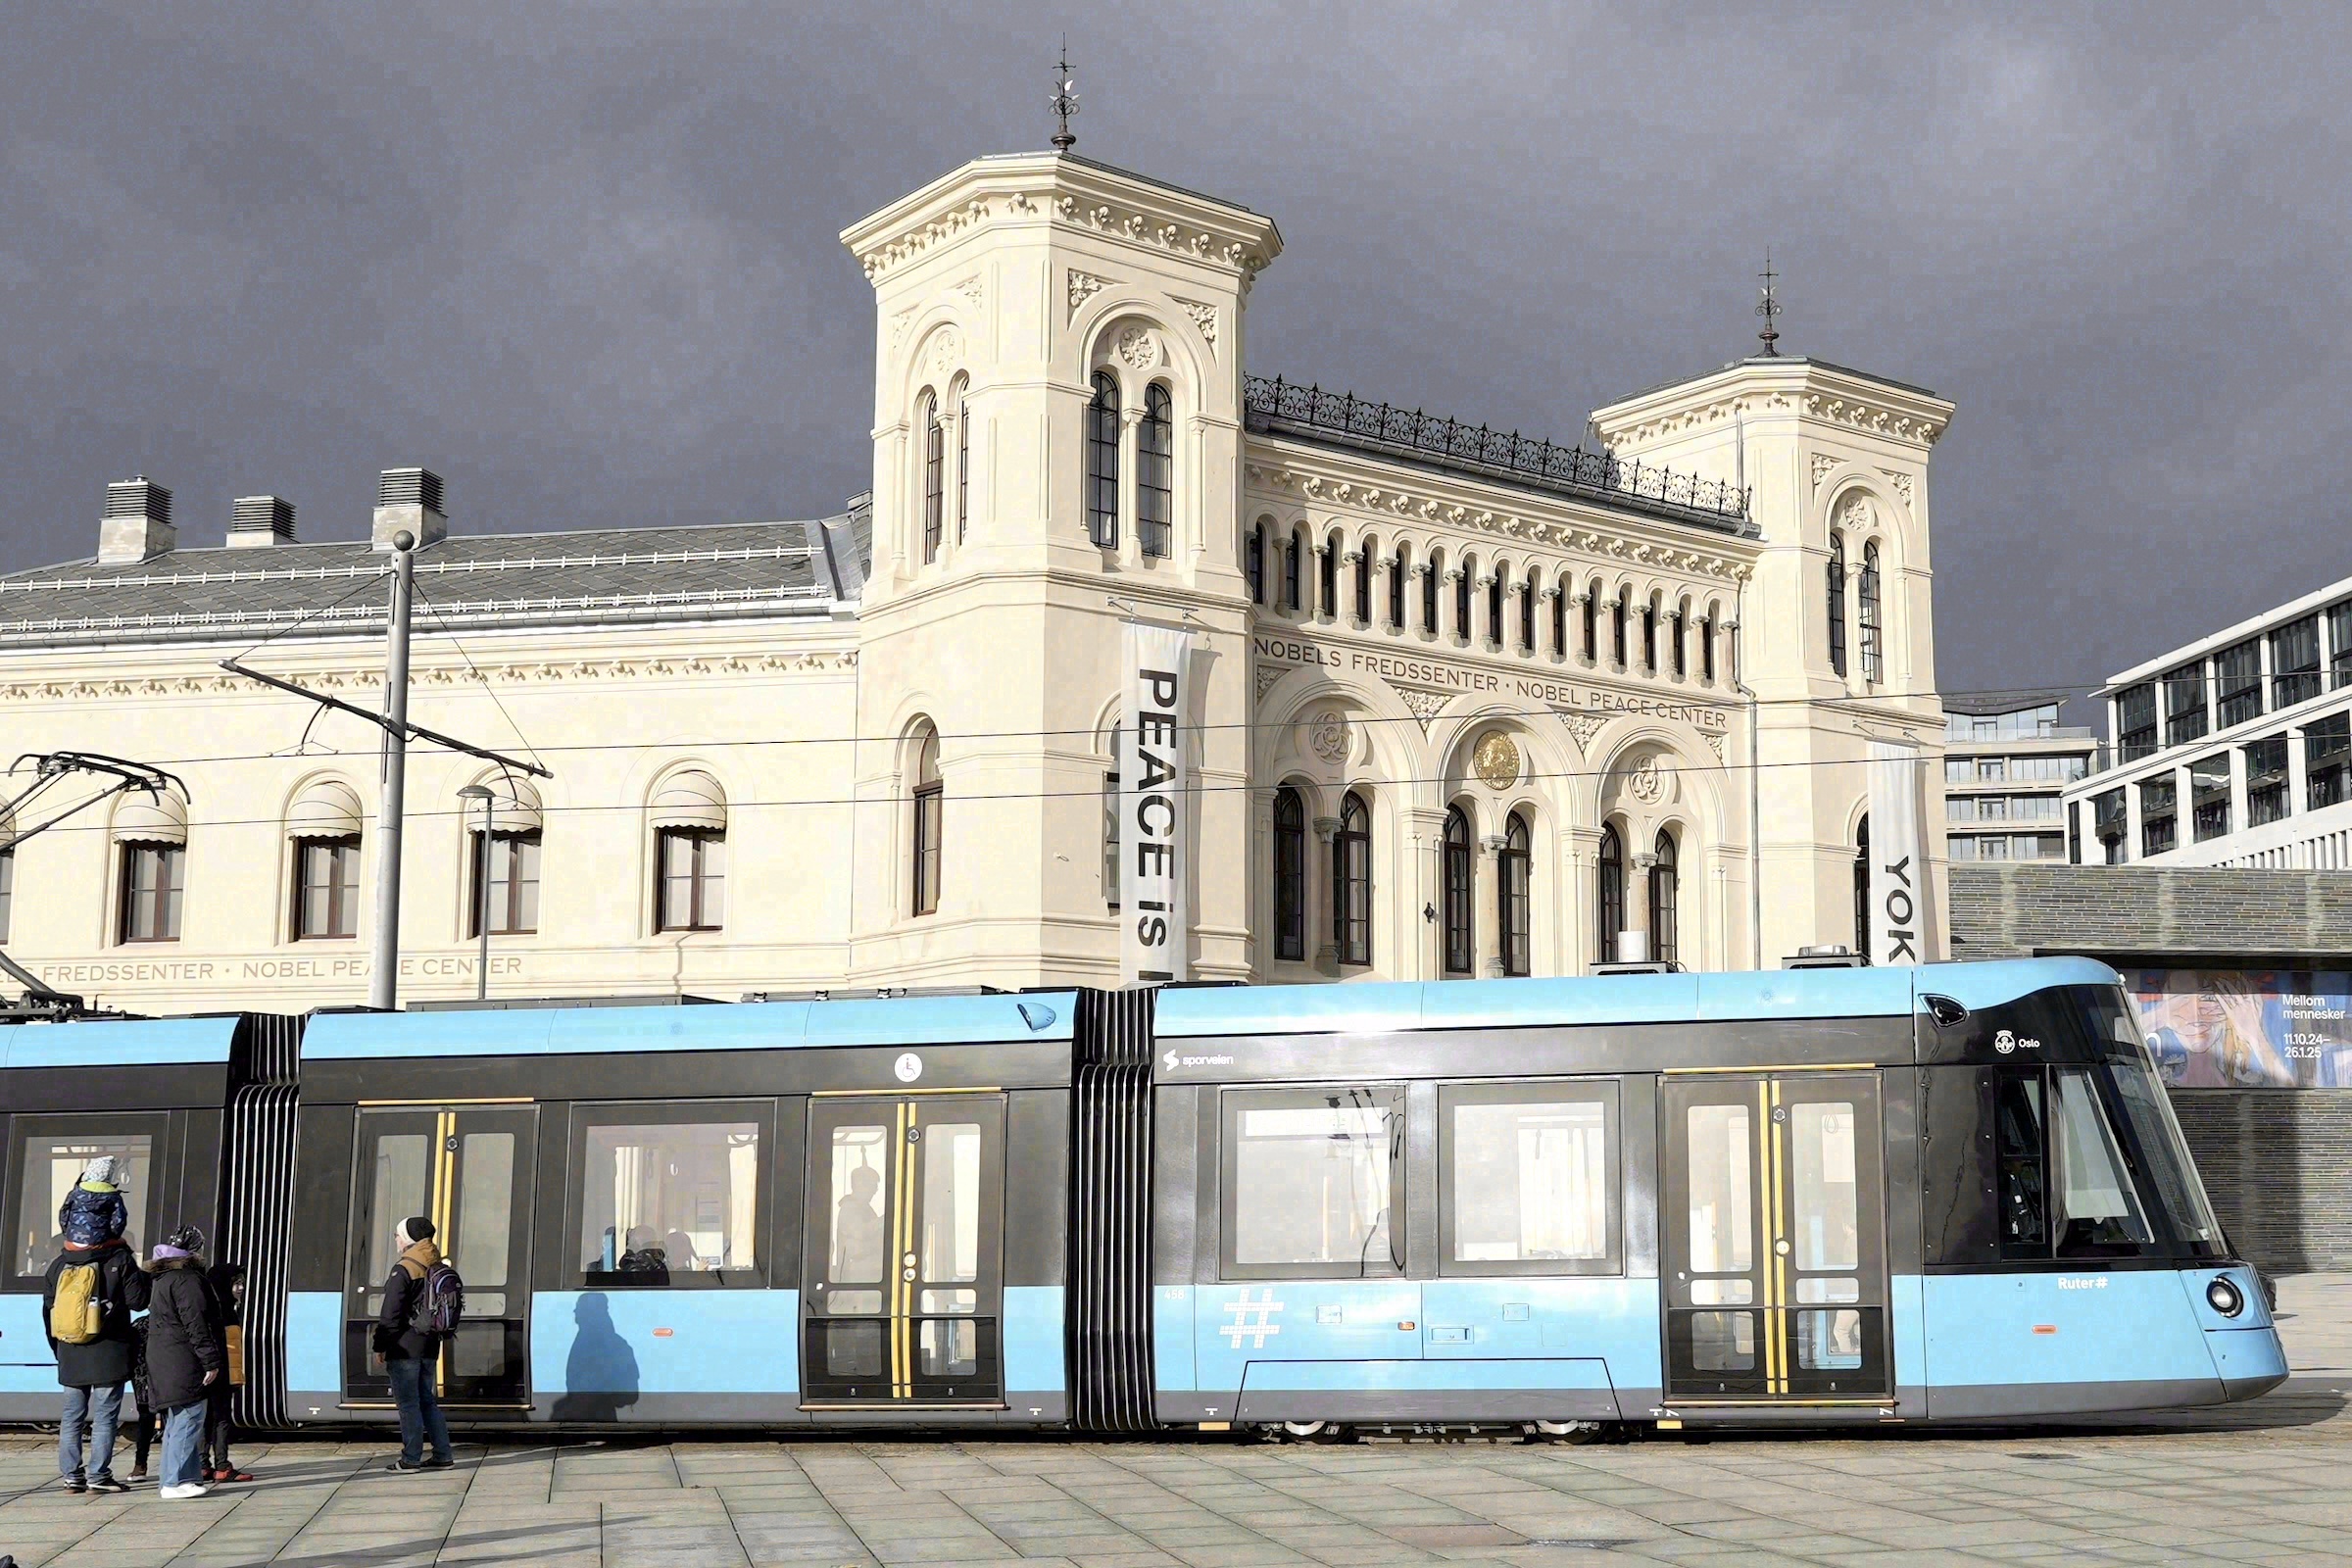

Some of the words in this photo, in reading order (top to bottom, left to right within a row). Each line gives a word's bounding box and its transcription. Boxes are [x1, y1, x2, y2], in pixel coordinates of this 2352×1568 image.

[1254, 638, 1342, 668] NOBELS
[1352, 655, 1498, 692] FREDSSENTER
[1517, 680, 1581, 705] NOBEL
[1590, 692, 1650, 715] PEACE
[1656, 703, 1726, 727] CENTER
[1137, 668, 1178, 878] PEACE
[43, 962, 214, 983] FREDSSENTER
[243, 961, 324, 978] NOBEL
[333, 959, 414, 977] PEE
[2282, 995, 2326, 1006] Mellom
[2282, 1008, 2345, 1020] mennesker
[2019, 1039, 2040, 1048] Oslo
[2284, 1047, 2323, 1058] 26.1.25
[1182, 1054, 1234, 1066] sporveien
